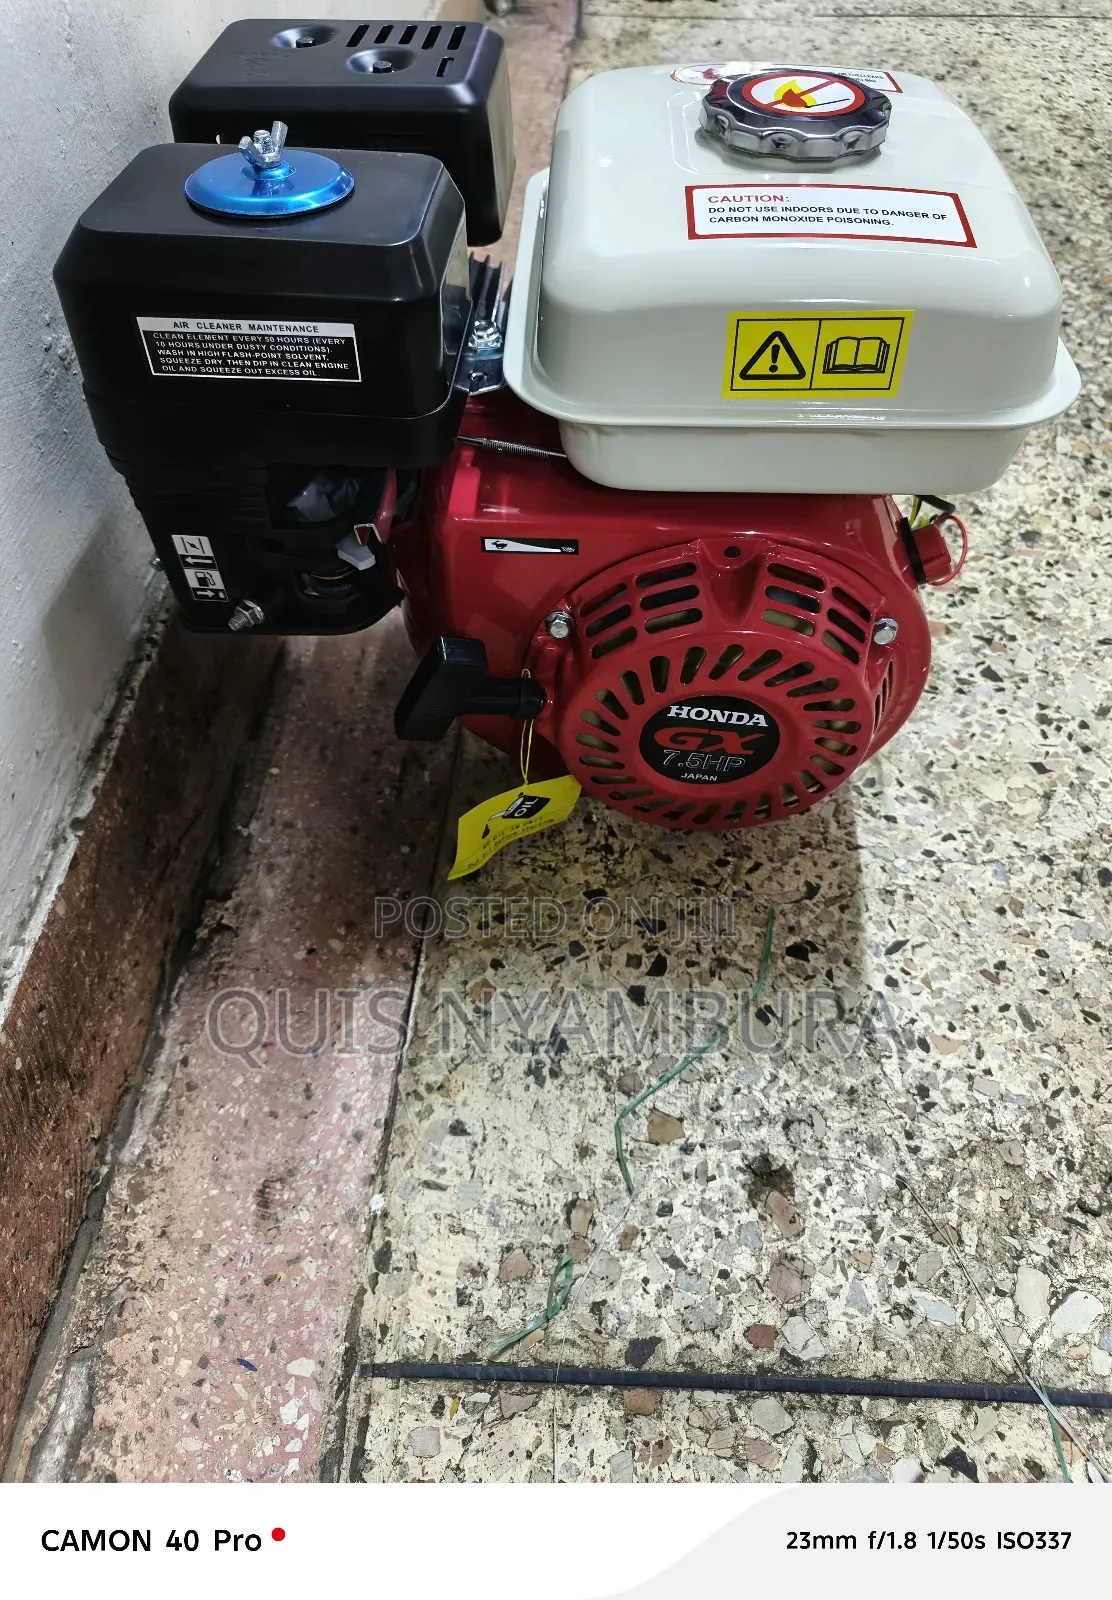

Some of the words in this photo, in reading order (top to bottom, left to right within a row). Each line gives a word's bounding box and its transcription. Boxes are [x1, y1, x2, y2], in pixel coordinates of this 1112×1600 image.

[708, 195, 789, 203] CAUTION:
[882, 210, 930, 218] DANGER
[827, 217, 894, 225] POISONING.
[197, 322, 242, 330] CLEANER
[248, 324, 319, 333] MAINTENANCE
[277, 336, 309, 344] HOURS
[270, 345, 332, 353] CONDITIONS).
[667, 705, 768, 727] HONDA
[654, 727, 767, 755] GX
[663, 749, 745, 772] 7.5HP
[681, 772, 718, 781] JAPAN
[514, 798, 539, 817] OIL
